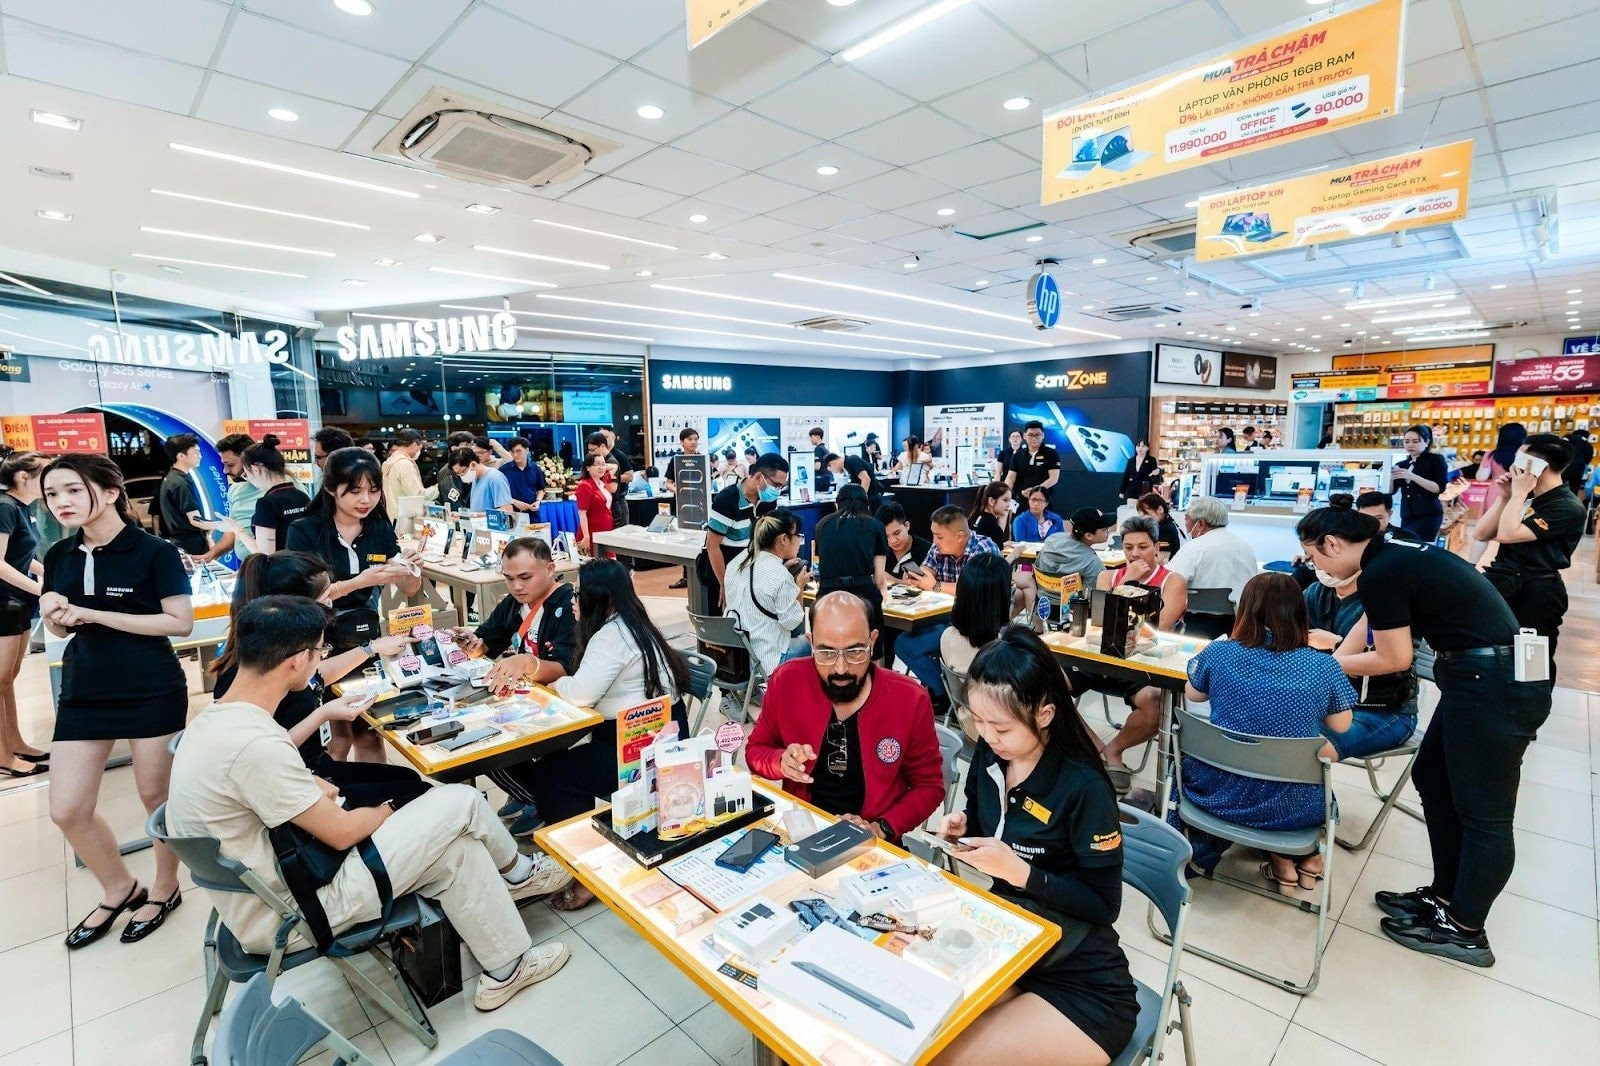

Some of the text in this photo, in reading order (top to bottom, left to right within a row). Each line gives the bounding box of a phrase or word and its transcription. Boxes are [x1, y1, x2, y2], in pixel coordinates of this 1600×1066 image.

[1203, 65, 1232, 82] MUA
[1235, 48, 1268, 72] TRẢ
[1271, 30, 1328, 60] CHẬM
[1178, 93, 1220, 113] LAPTOP
[1222, 84, 1245, 100] VĂN
[1247, 72, 1289, 92] PHÒNG
[1292, 62, 1323, 79] 16GB
[1326, 51, 1355, 67] RAM
[1179, 112, 1198, 125] 0%
[1199, 107, 1213, 120] LÃI
[1214, 101, 1235, 117] SUẤT
[1242, 92, 1275, 108] KHÔNG
[1296, 78, 1315, 92] TRẢ
[1317, 67, 1353, 85] TRƯỚC
[1314, 91, 1364, 115] 90.000
[1240, 114, 1277, 131] OFFICE
[1169, 130, 1227, 155] 11.990.000
[1330, 174, 1352, 185] MUA
[1354, 165, 1379, 181] TRẢ
[1381, 157, 1423, 174] CHẬM
[1323, 189, 1351, 202] Laptop
[1352, 184, 1385, 198] Gaming
[1386, 179, 1408, 190] Card
[1409, 175, 1428, 185] RTX
[1227, 190, 1267, 206] LAPTOP
[1418, 200, 1453, 213] 90.000
[1311, 205, 1325, 213] 0%
[1038, 274, 1058, 328] hp
[336, 311, 518, 362] SAMSUNG
[0, 363, 22, 375] ong
[58, 359, 174, 380] Galaxy S25 Series
[1552, 364, 1585, 382] 5G
[88, 378, 129, 392] Galaxy
[661, 374, 733, 391] SAMSUNG
[9, 437, 29, 448] BÁN
[281, 450, 308, 463] HẬM
[208, 465, 229, 500] Series
[476, 536, 491, 545] oppo
[1011, 842, 1046, 855] SAMSUNG
